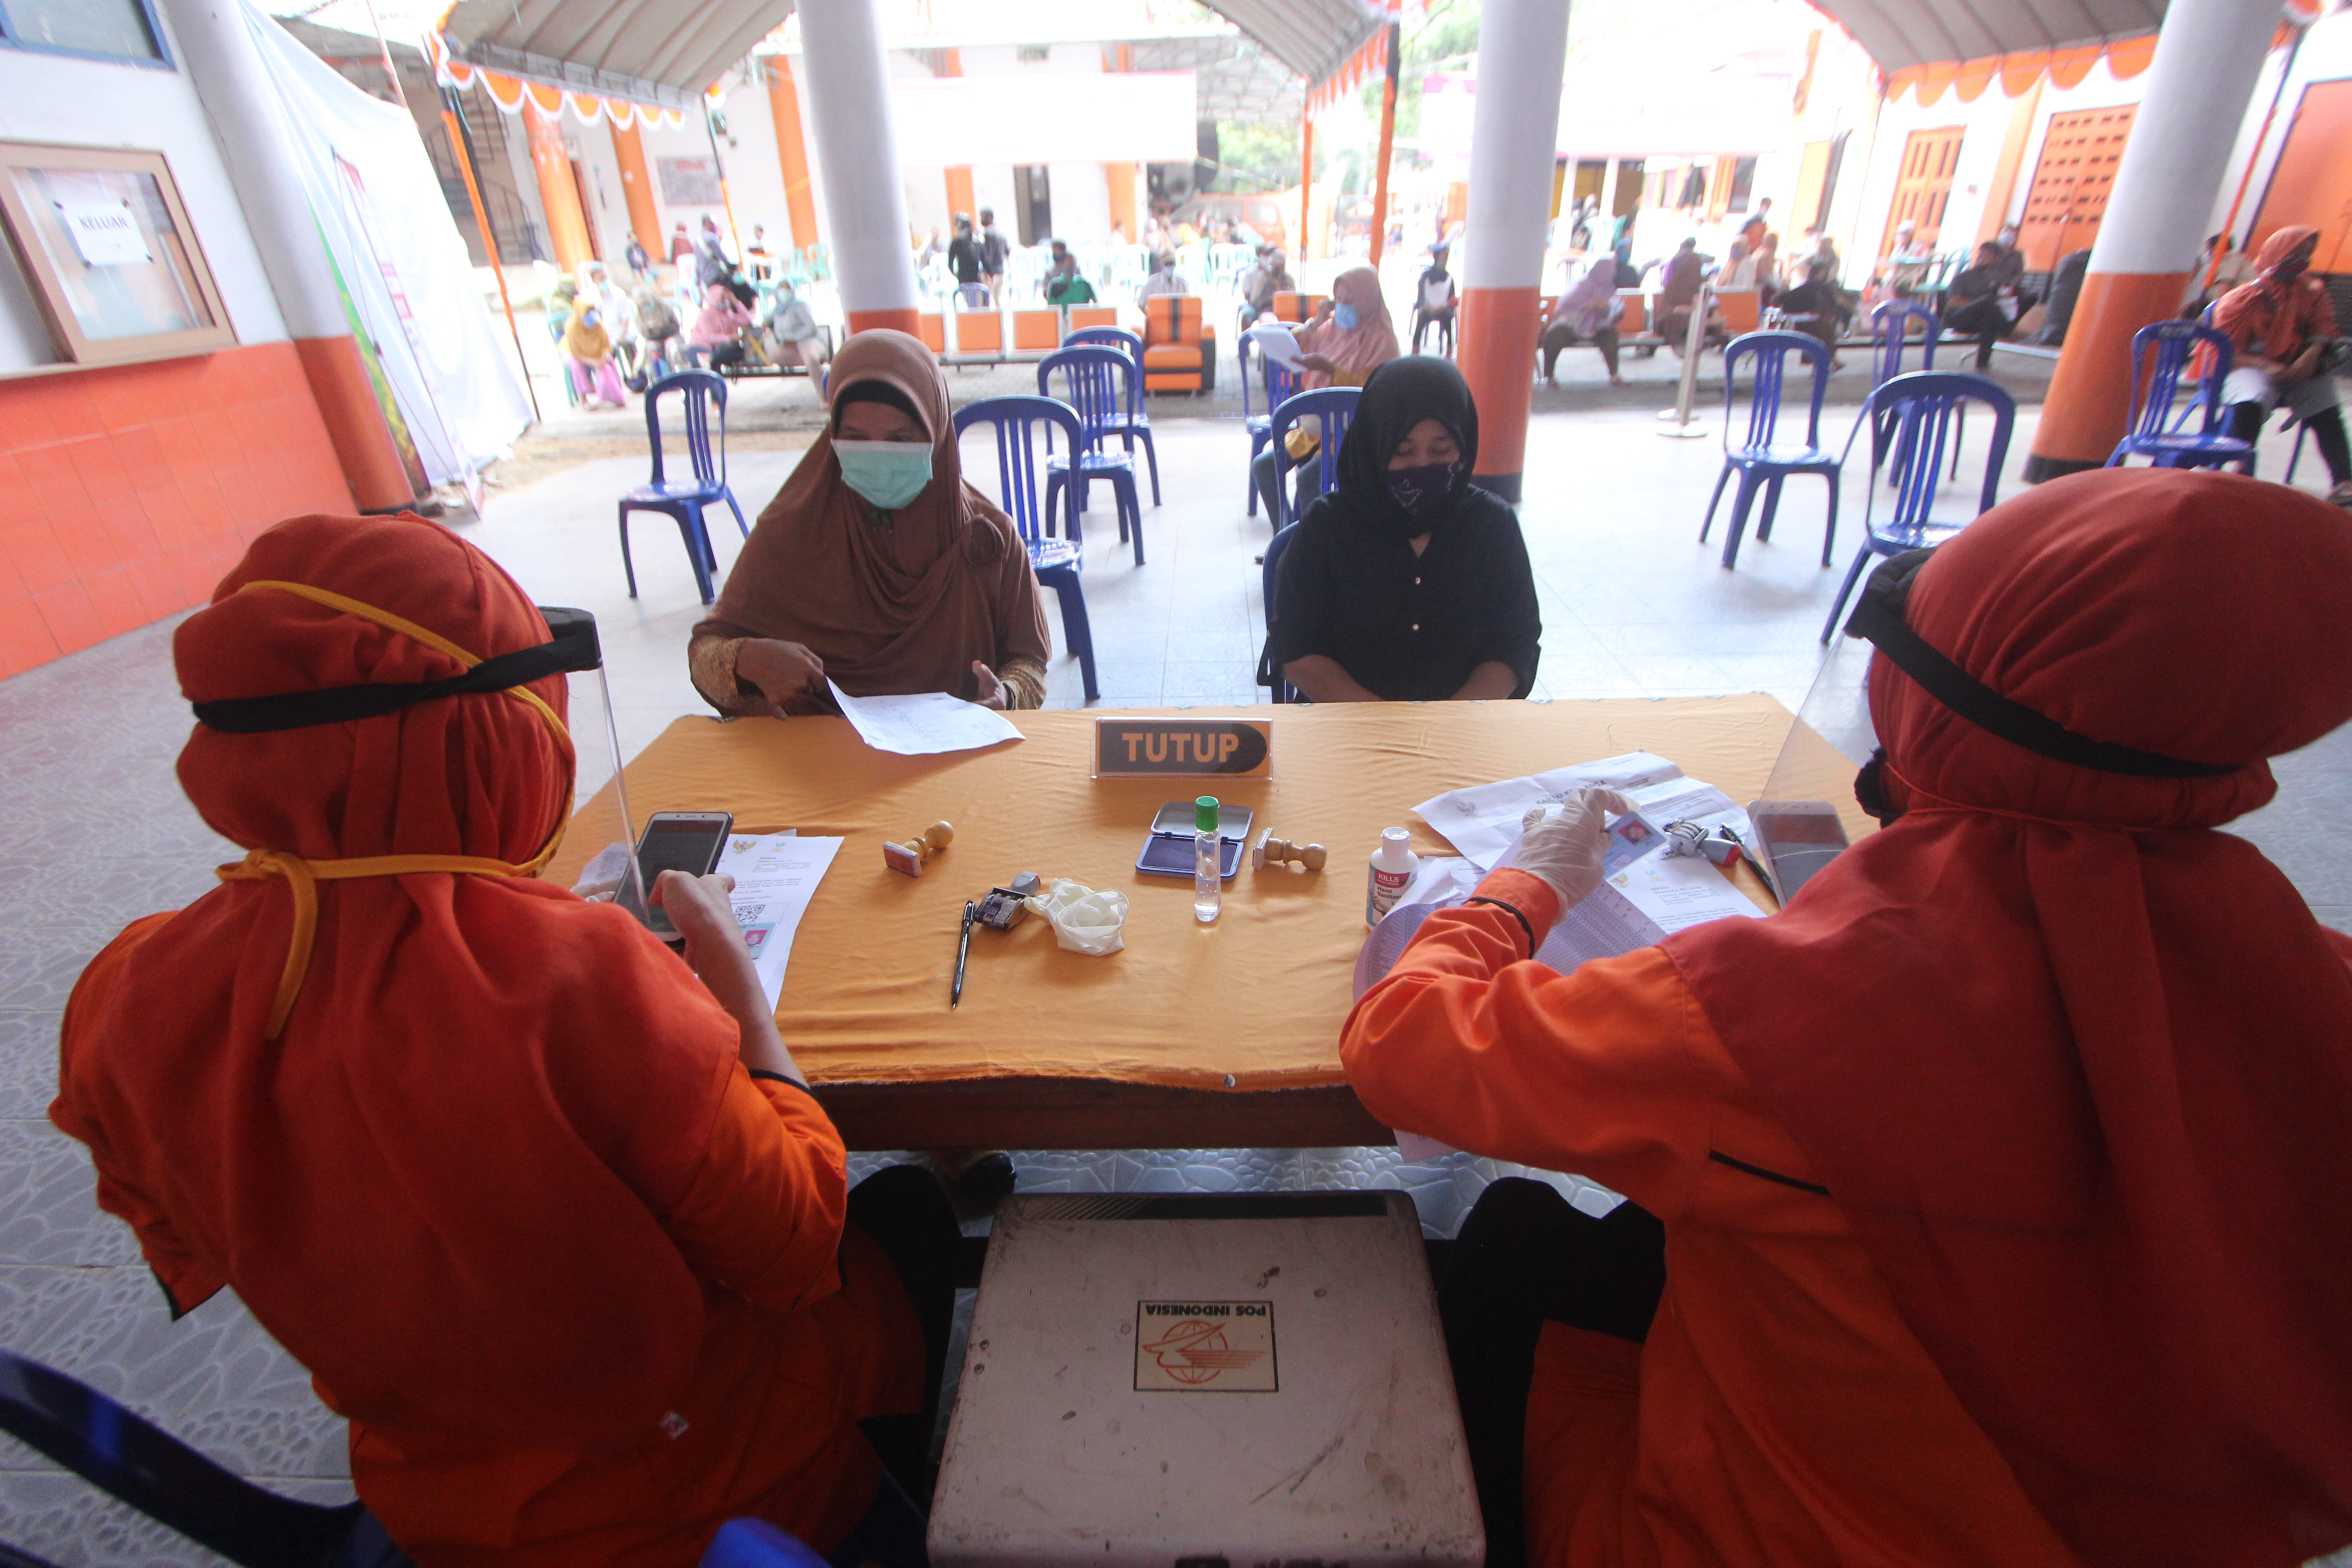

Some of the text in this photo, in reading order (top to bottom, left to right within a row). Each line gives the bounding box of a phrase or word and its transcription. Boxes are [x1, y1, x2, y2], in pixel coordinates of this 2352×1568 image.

[77, 215, 130, 230] KELUAR
[1122, 732, 1239, 763] TUTUP
[1378, 873, 1399, 882] KILLS
[1145, 1305, 1266, 1316] POS INDONESIA
